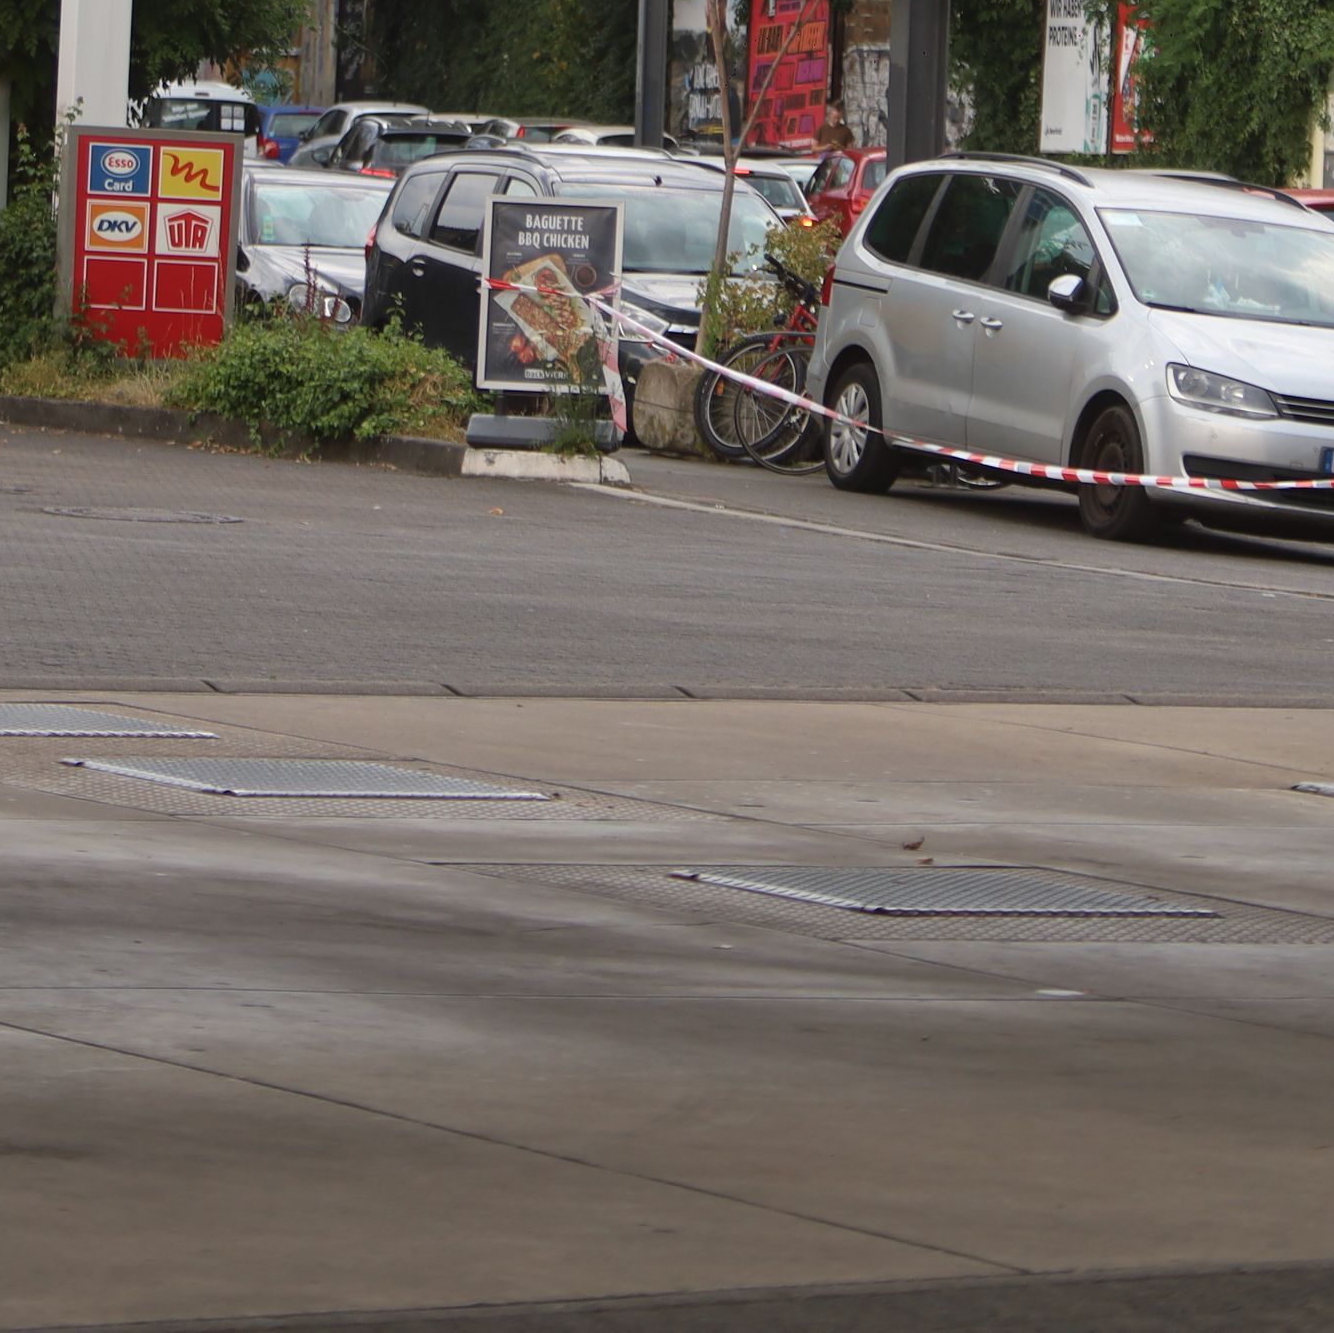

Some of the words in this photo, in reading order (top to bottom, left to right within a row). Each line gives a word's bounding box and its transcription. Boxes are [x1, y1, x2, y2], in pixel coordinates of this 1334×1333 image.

[107, 156, 134, 168] Esso
[104, 179, 134, 192] Card
[97, 219, 138, 233] DKV
[526, 214, 584, 232] BAGUETTE
[518, 231, 541, 249] BBQ
[544, 232, 590, 250] CHICKEN
